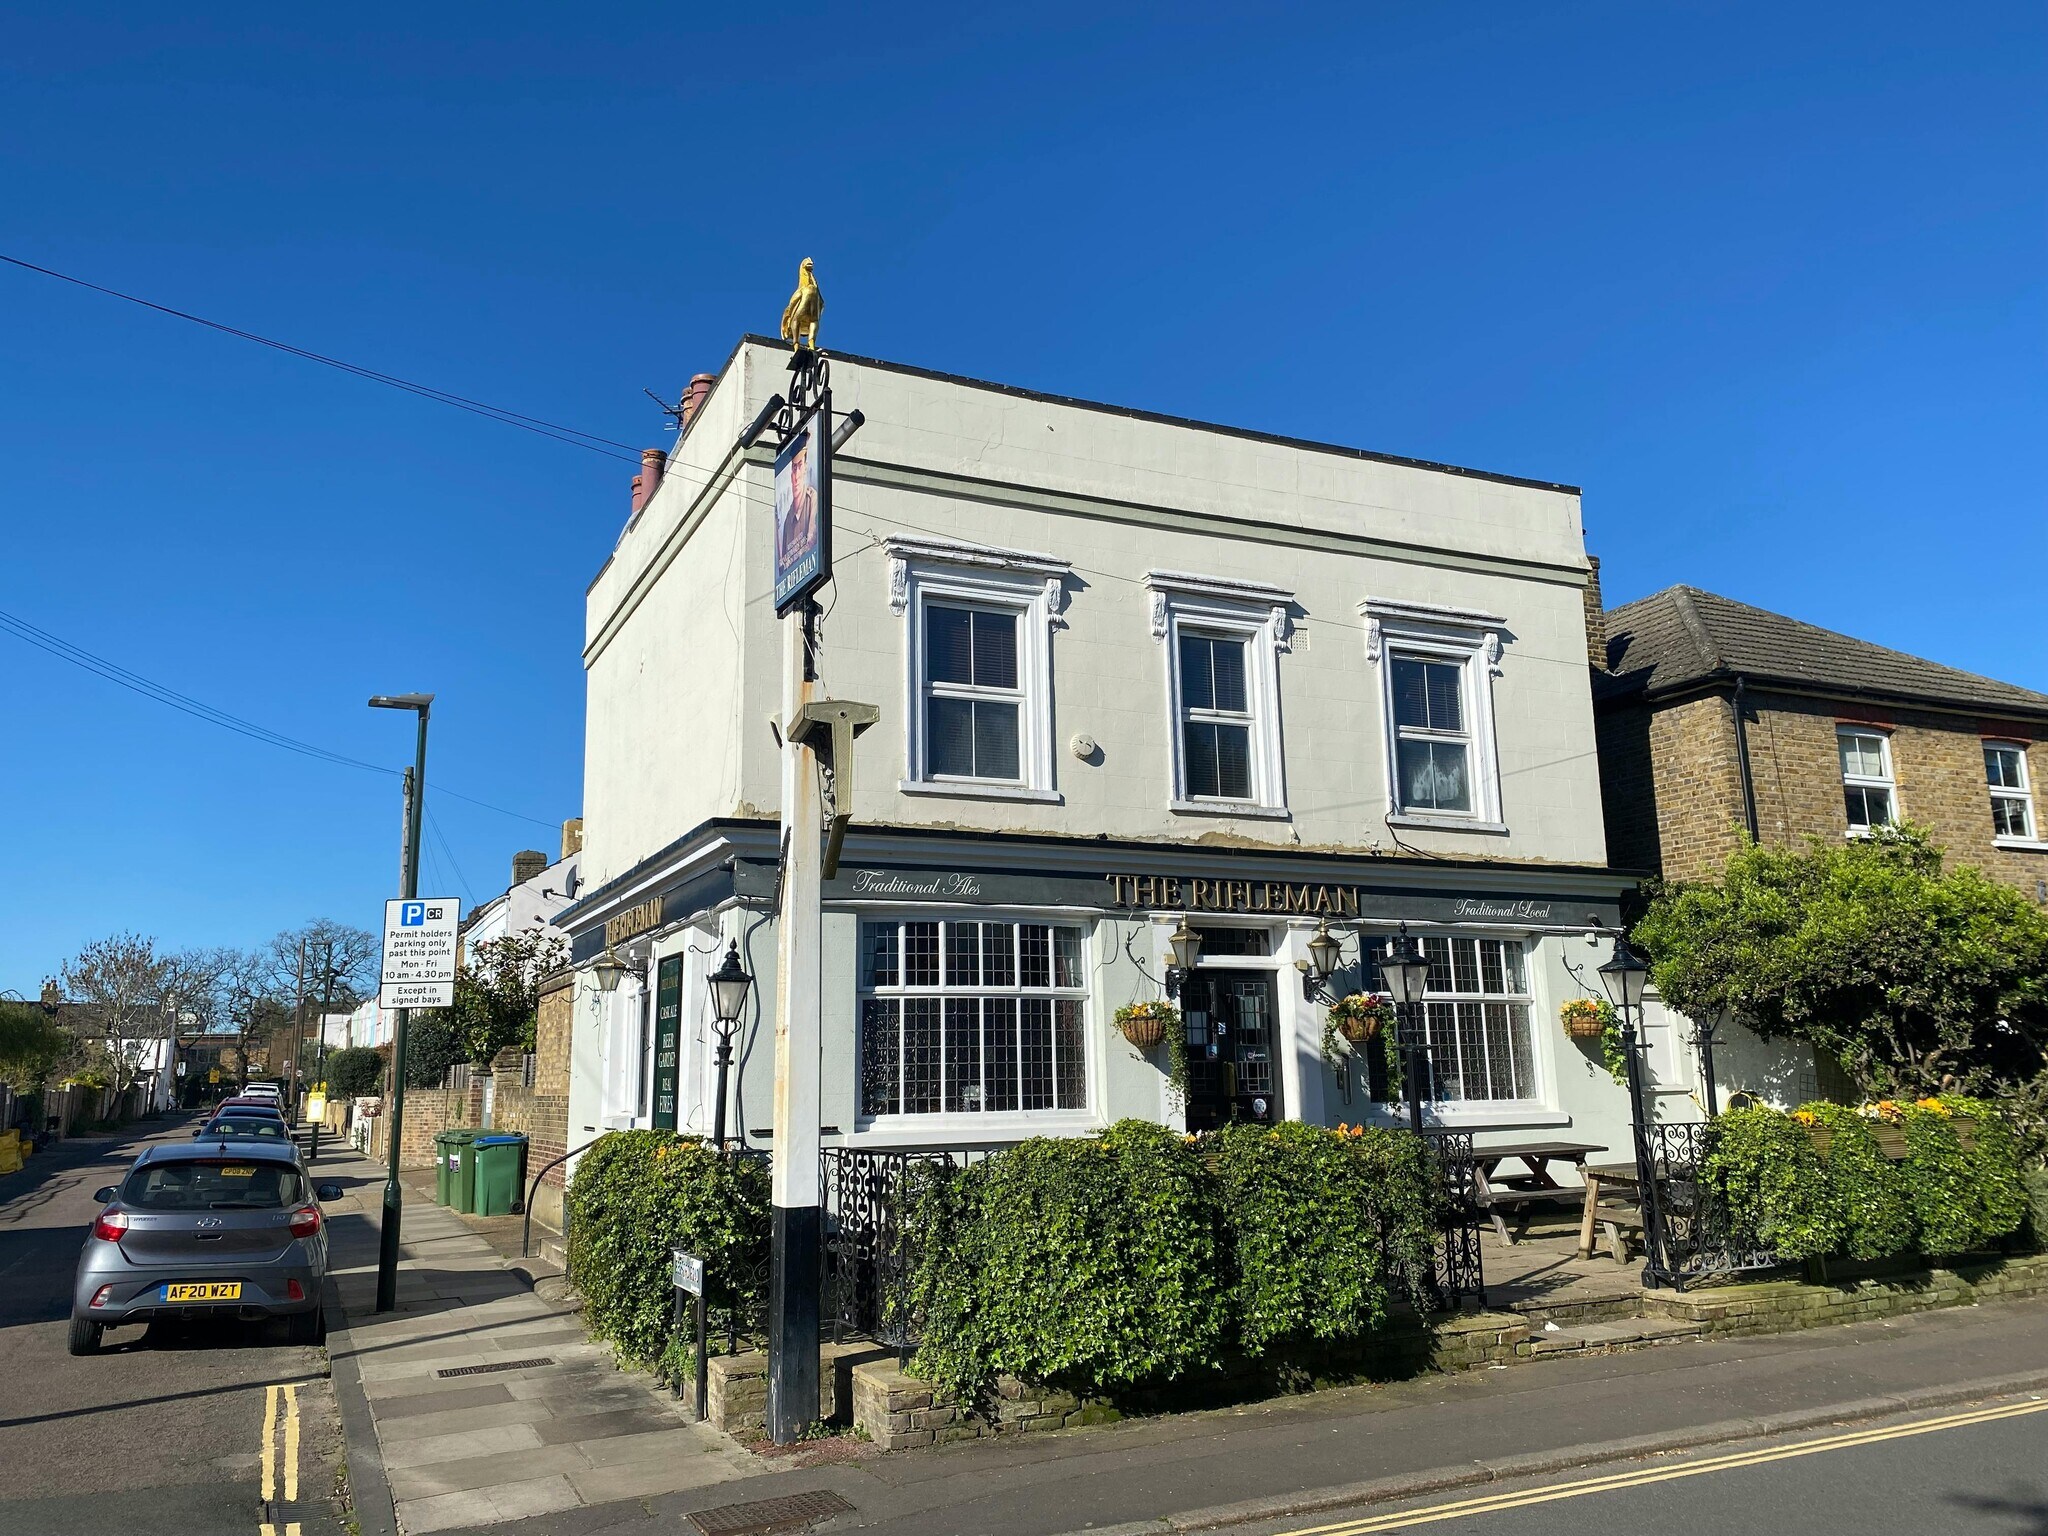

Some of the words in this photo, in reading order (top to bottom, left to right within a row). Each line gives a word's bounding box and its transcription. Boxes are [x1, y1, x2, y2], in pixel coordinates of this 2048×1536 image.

[852, 869, 941, 894] Traditional
[942, 872, 981, 896] Ales
[1105, 873, 1183, 907] THE
[1190, 878, 1360, 916] RIFLEMAN
[1454, 897, 1516, 917] Traditional
[1517, 899, 1551, 919] Local
[406, 905, 422, 925] P
[427, 909, 442, 919] CR
[390, 930, 418, 939] Permit
[420, 930, 452, 938] holders
[393, 940, 426, 949] parking
[428, 939, 447, 948] only
[388, 949, 407, 959] past
[410, 949, 426, 957] this
[428, 948, 451, 957] point
[400, 960, 420, 969] Mon
[426, 959, 438, 968] Fri
[385, 971, 395, 979] 10
[415, 970, 437, 979] 4.30
[438, 971, 452, 979] pm
[397, 986, 427, 995] Except
[429, 986, 437, 994] in
[391, 996, 420, 1005] signed
[421, 995, 442, 1005] bays
[662, 1032, 675, 1049] BEER
[170, 1286, 207, 1298] AF20
[211, 1284, 238, 1297] WZT
